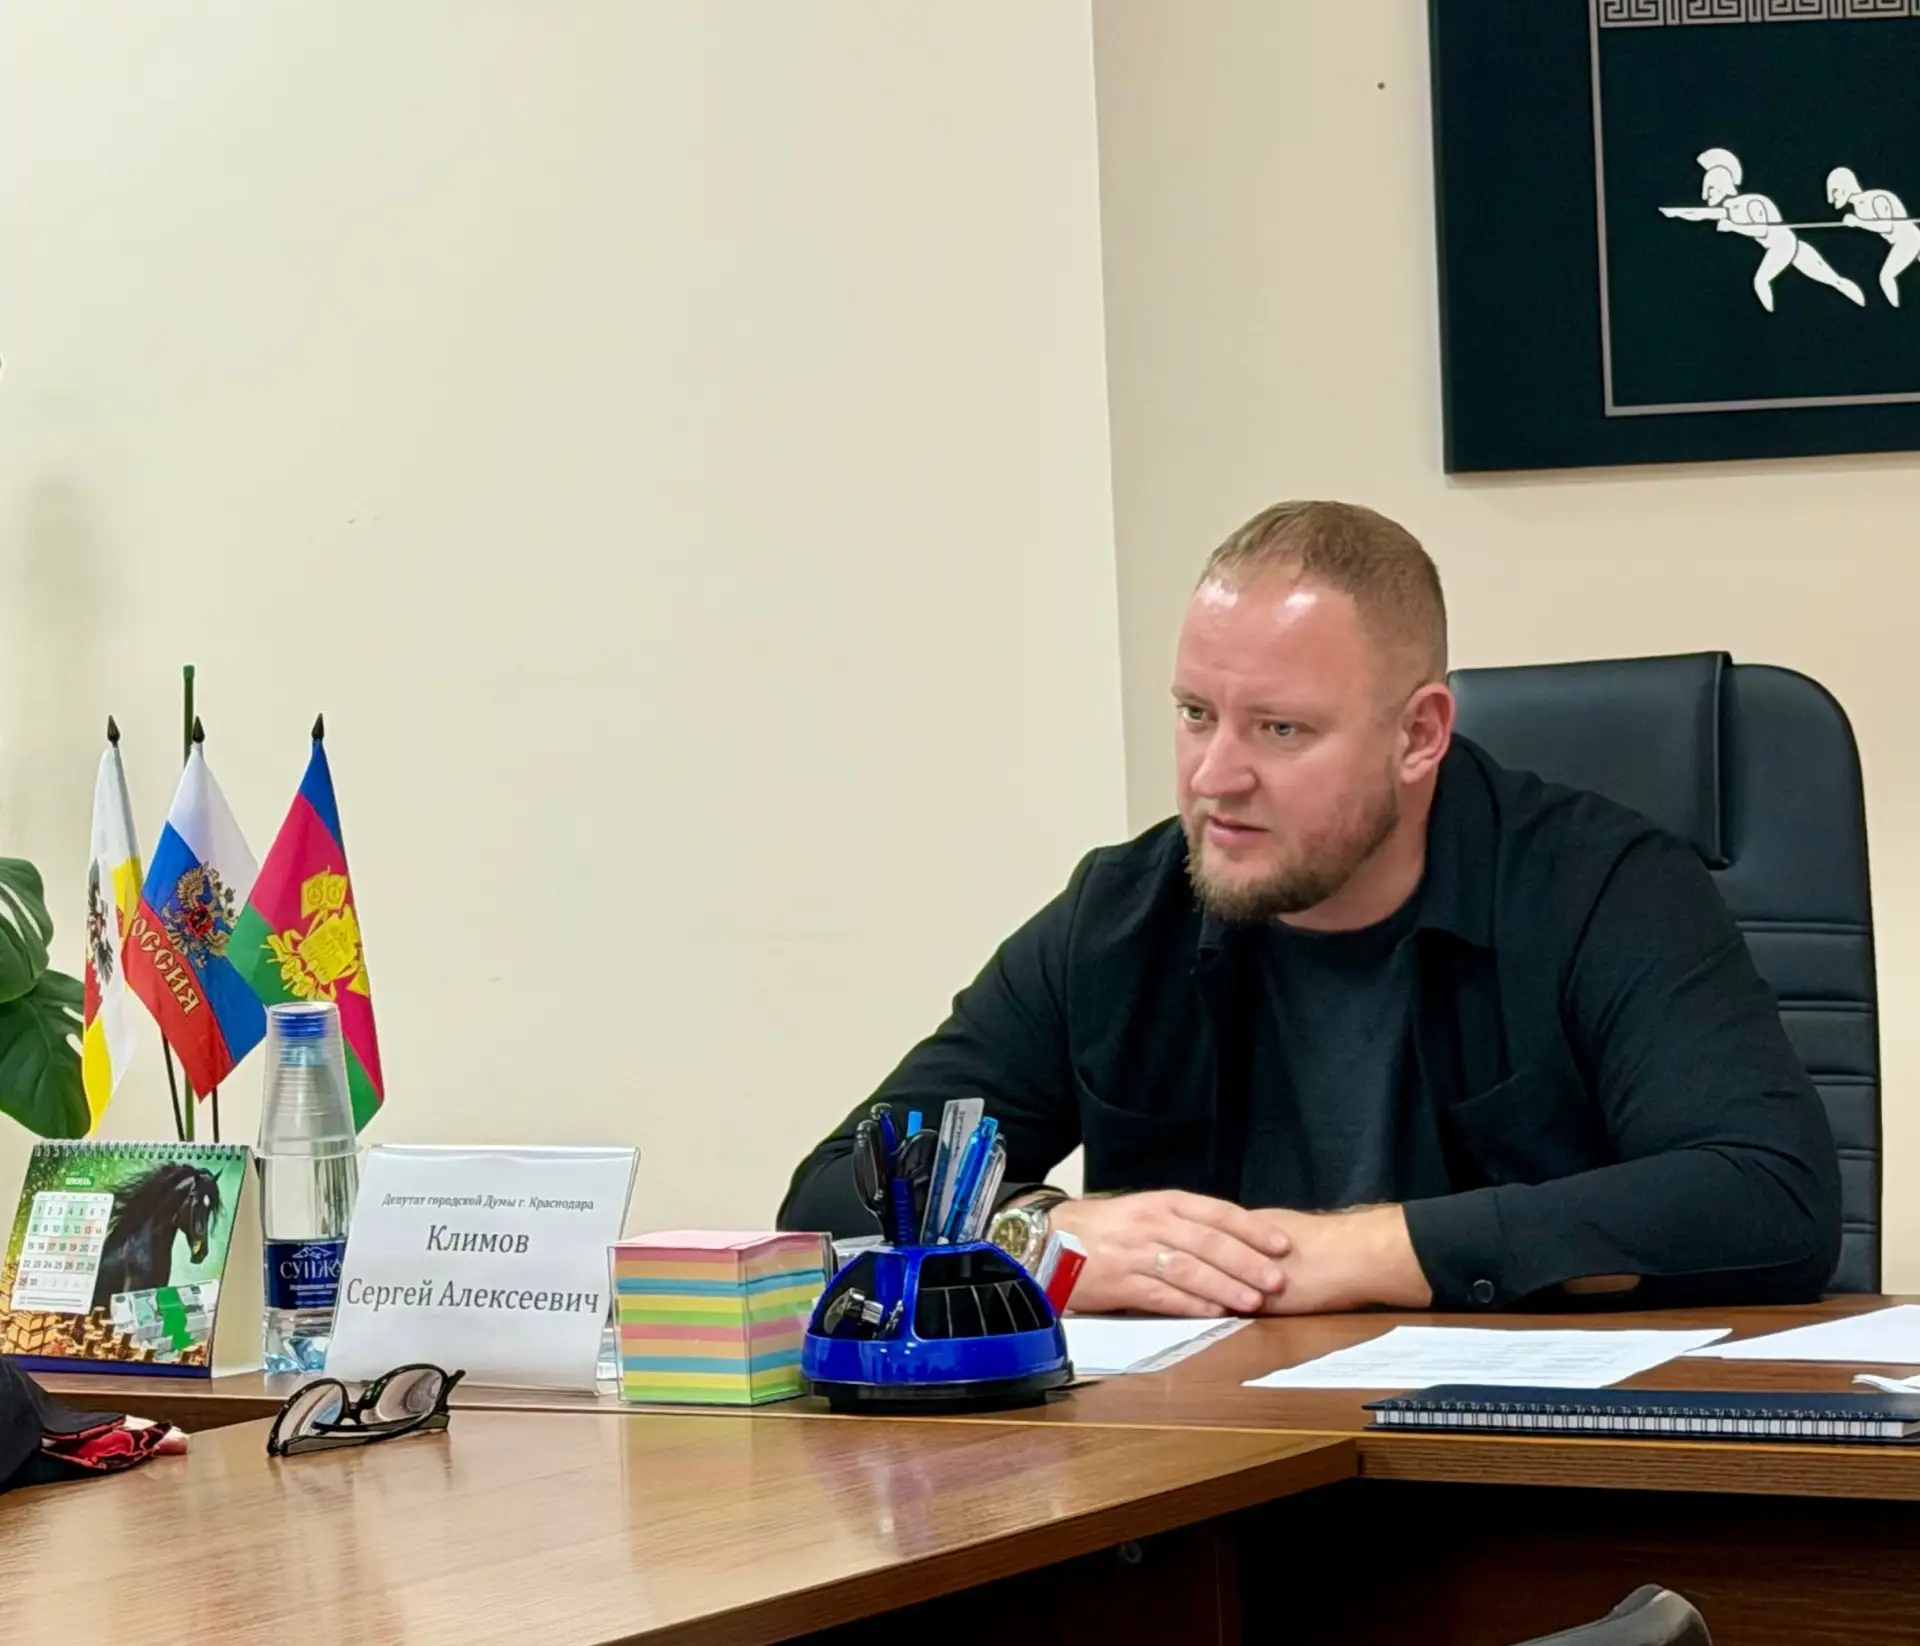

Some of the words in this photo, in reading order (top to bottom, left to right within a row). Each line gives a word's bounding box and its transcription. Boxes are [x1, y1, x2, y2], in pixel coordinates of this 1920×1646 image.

[131, 911, 201, 1015] ОССИЯ
[382, 1193, 426, 1208] Депутат
[427, 1194, 482, 1209] городской
[483, 1195, 516, 1210] Думы
[518, 1199, 527, 1208] г.
[528, 1197, 595, 1212] Краснодара
[426, 1225, 530, 1254] Климов
[346, 1278, 434, 1312] Сергей
[437, 1280, 600, 1314] Алексеевич
